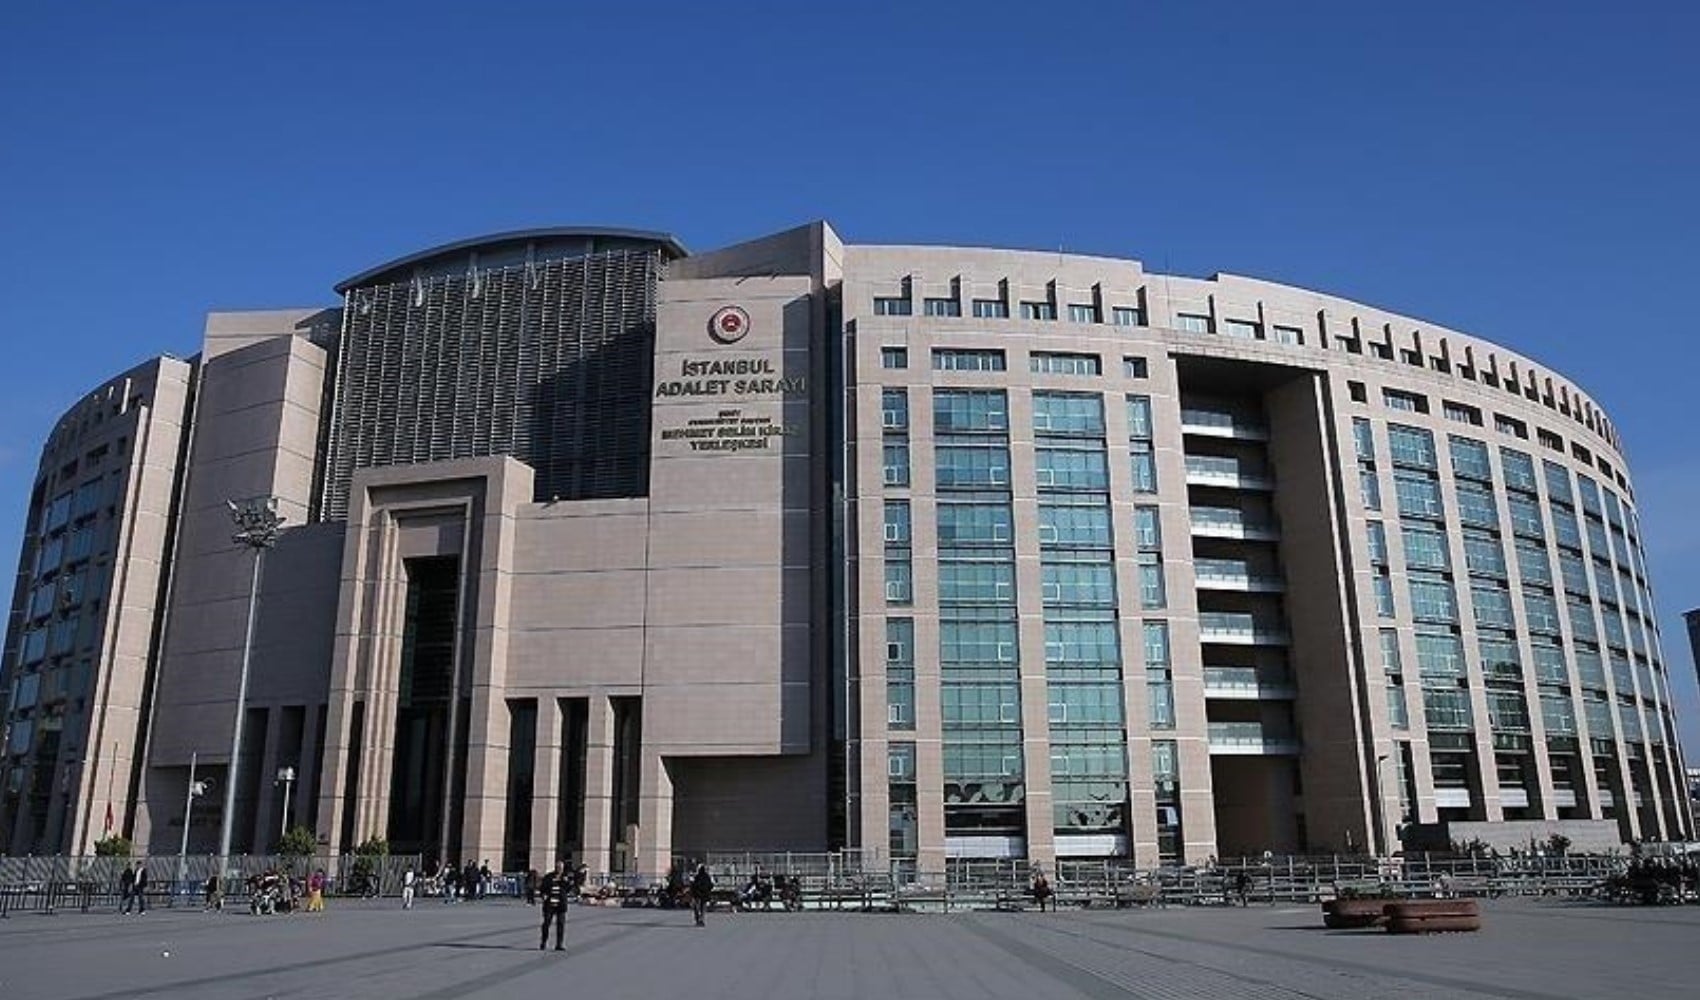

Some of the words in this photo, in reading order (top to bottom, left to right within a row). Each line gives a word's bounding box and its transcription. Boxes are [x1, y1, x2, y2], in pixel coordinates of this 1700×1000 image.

[682, 359, 775, 376] İSTANBUL
[656, 380, 730, 397] ADALET
[734, 376, 806, 395] SARAYI
